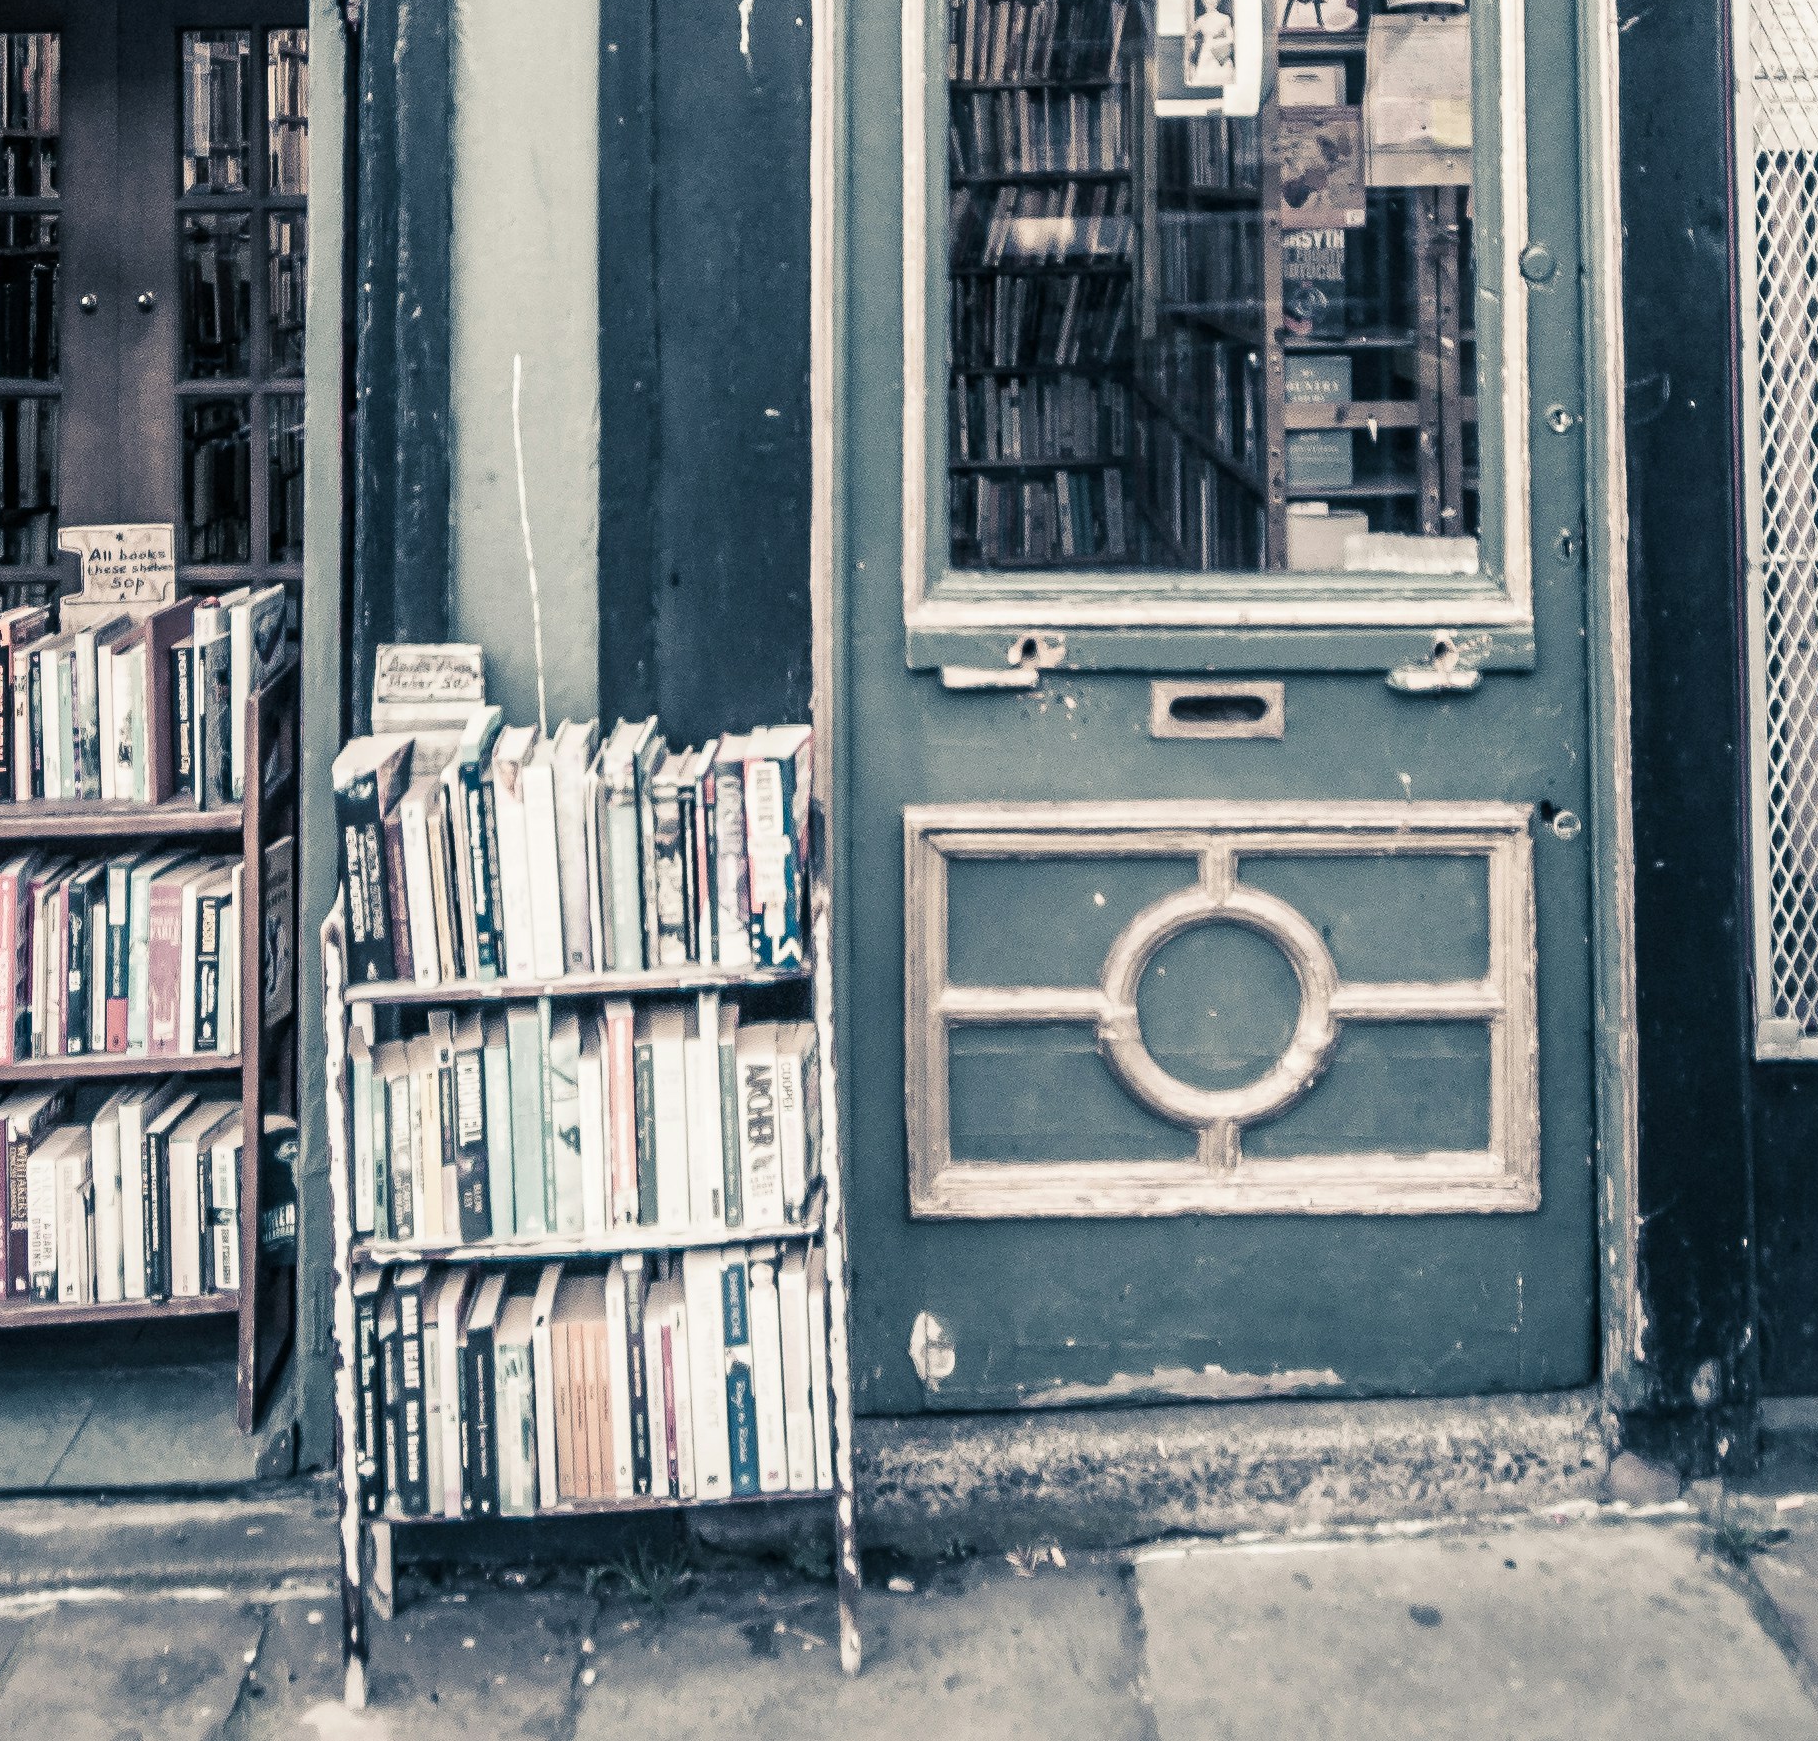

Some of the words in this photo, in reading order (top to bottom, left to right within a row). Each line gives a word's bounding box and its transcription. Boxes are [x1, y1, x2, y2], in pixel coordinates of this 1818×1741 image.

[87, 564, 127, 576] these
[88, 548, 112, 562] All
[119, 546, 166, 560] books
[111, 577, 145, 596] 50p
[457, 1064, 482, 1147] CORNWELL
[780, 1062, 794, 1113] COOPER
[390, 1082, 410, 1151] CORNWELL
[745, 1064, 775, 1151] ARCHER
[463, 1191, 473, 1208] FLY
[472, 1183, 483, 1214] BLOW
[42, 1232, 53, 1261] DARK
[401, 1295, 418, 1336] DARK
[403, 1340, 420, 1389] HEART
[406, 1400, 419, 1433] Nick
[407, 1434, 419, 1482] Davies
